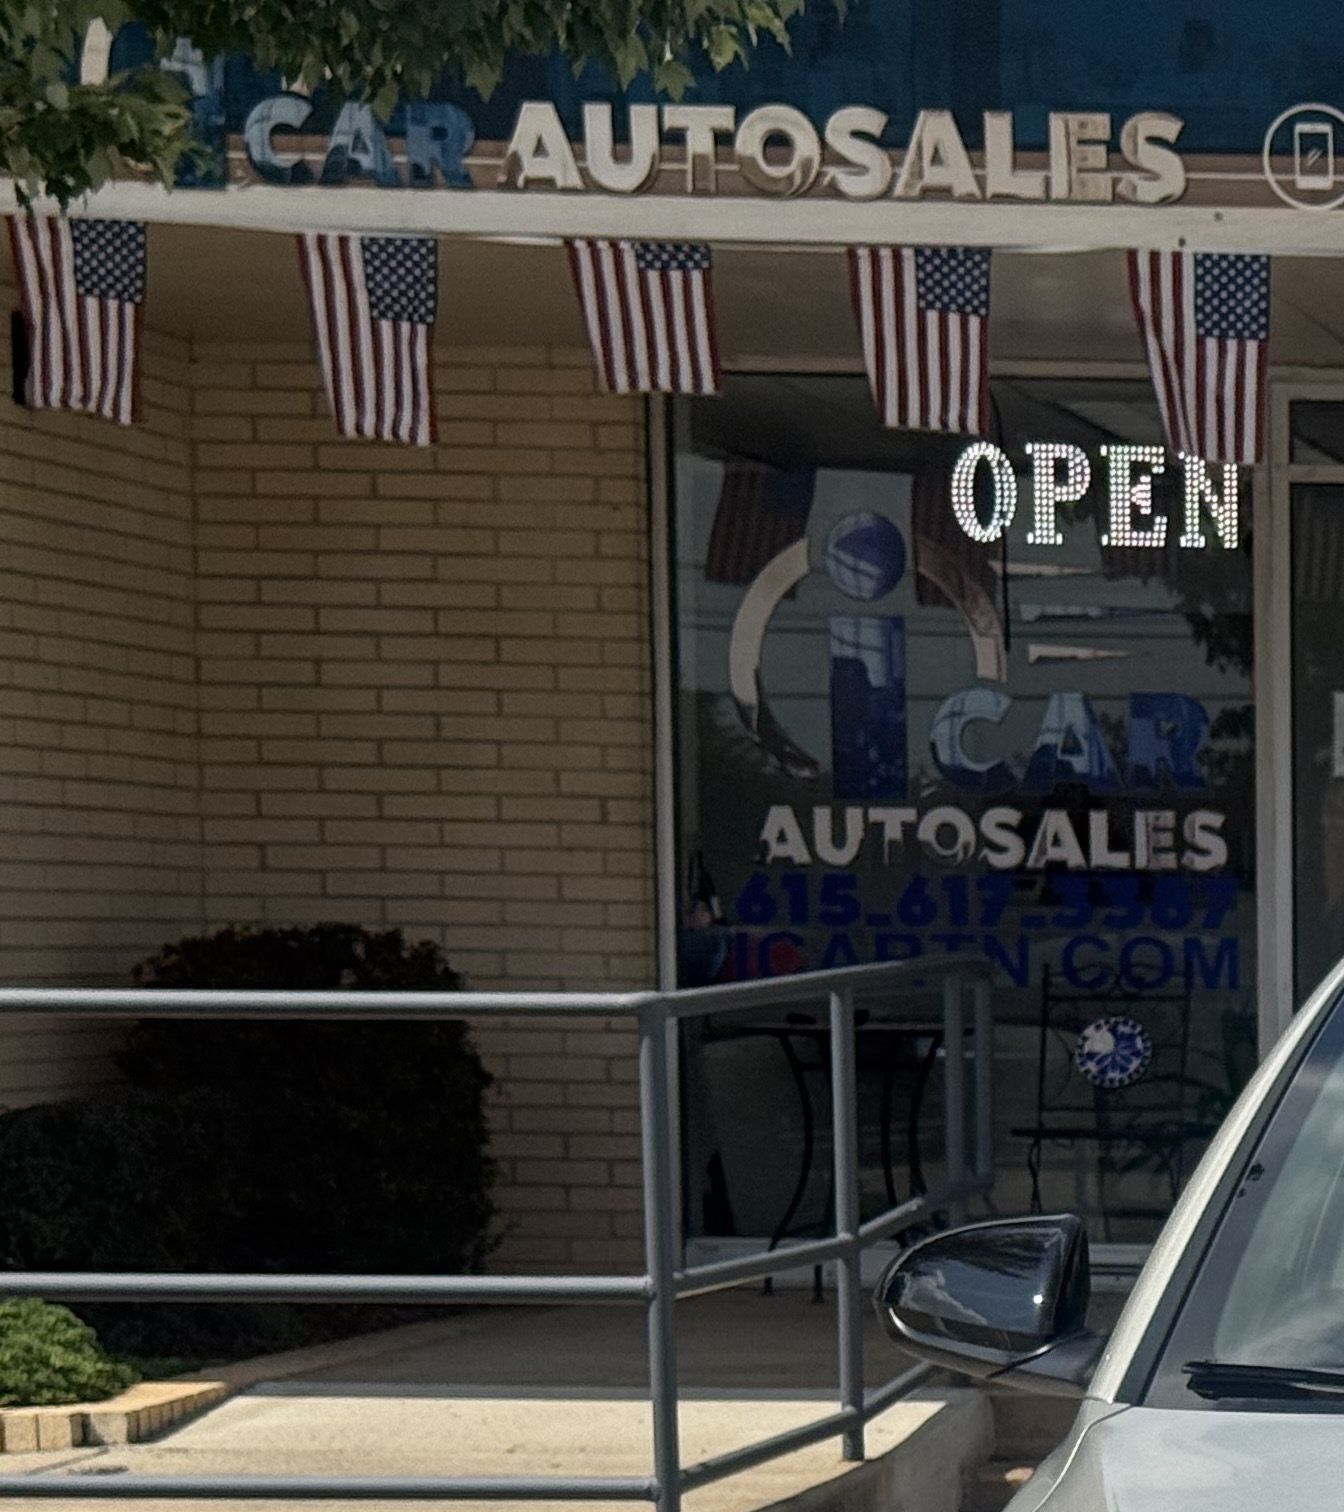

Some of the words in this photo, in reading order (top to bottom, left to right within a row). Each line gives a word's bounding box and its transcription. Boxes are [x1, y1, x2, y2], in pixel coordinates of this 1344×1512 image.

[245, 92, 476, 190] CAR
[500, 100, 1189, 206] AUTOSALES
[950, 440, 1240, 550] OPEN
[930, 686, 1213, 796] CAR
[756, 803, 1229, 872] AUTOSALES
